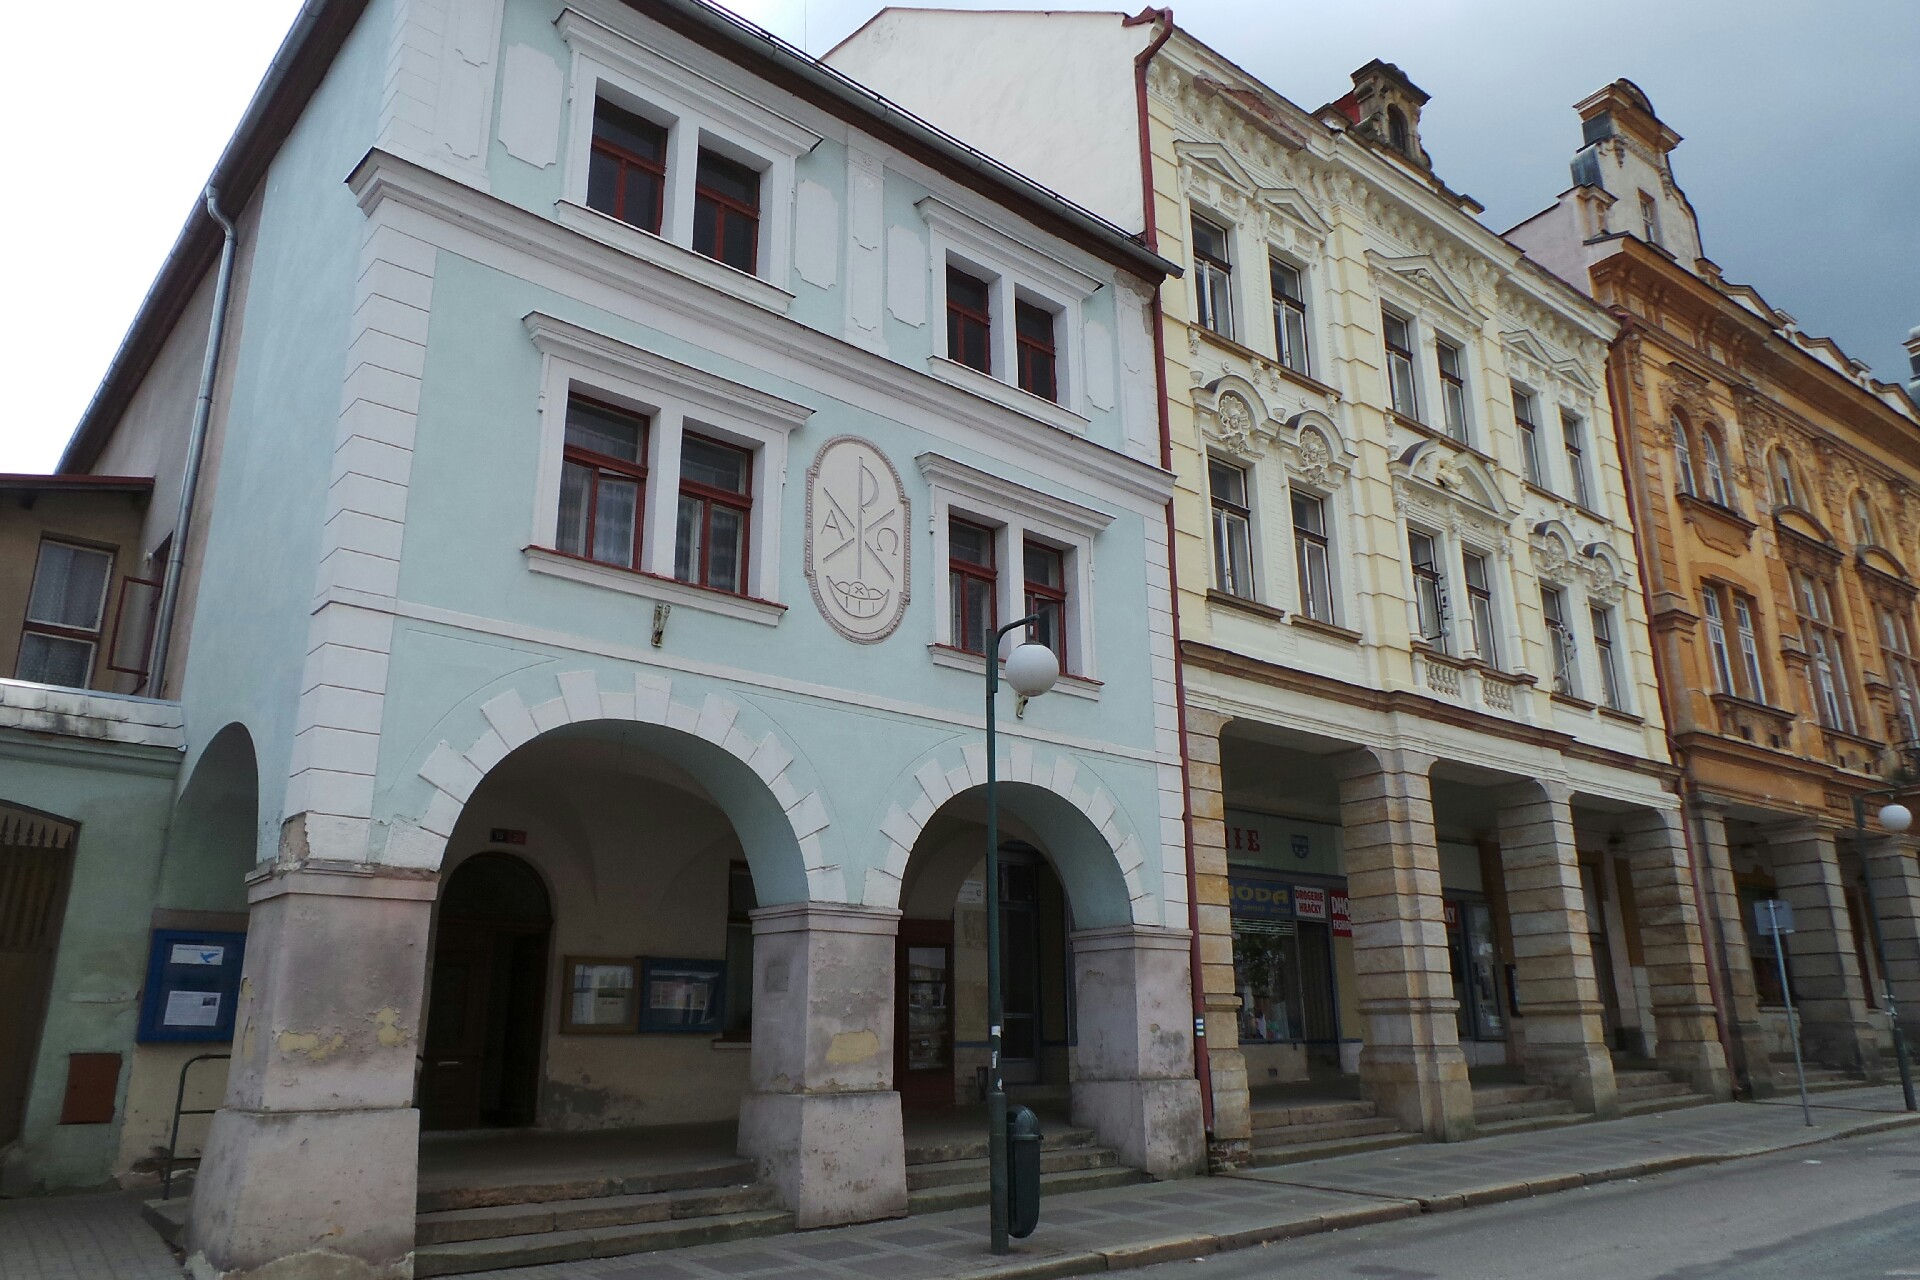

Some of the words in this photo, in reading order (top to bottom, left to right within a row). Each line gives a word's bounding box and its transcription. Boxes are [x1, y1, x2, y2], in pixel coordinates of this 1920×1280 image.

[1225, 825, 1260, 852] IE
[1295, 890, 1324, 902] DROGERIE
[1299, 901, 1321, 914] HRAČKY
